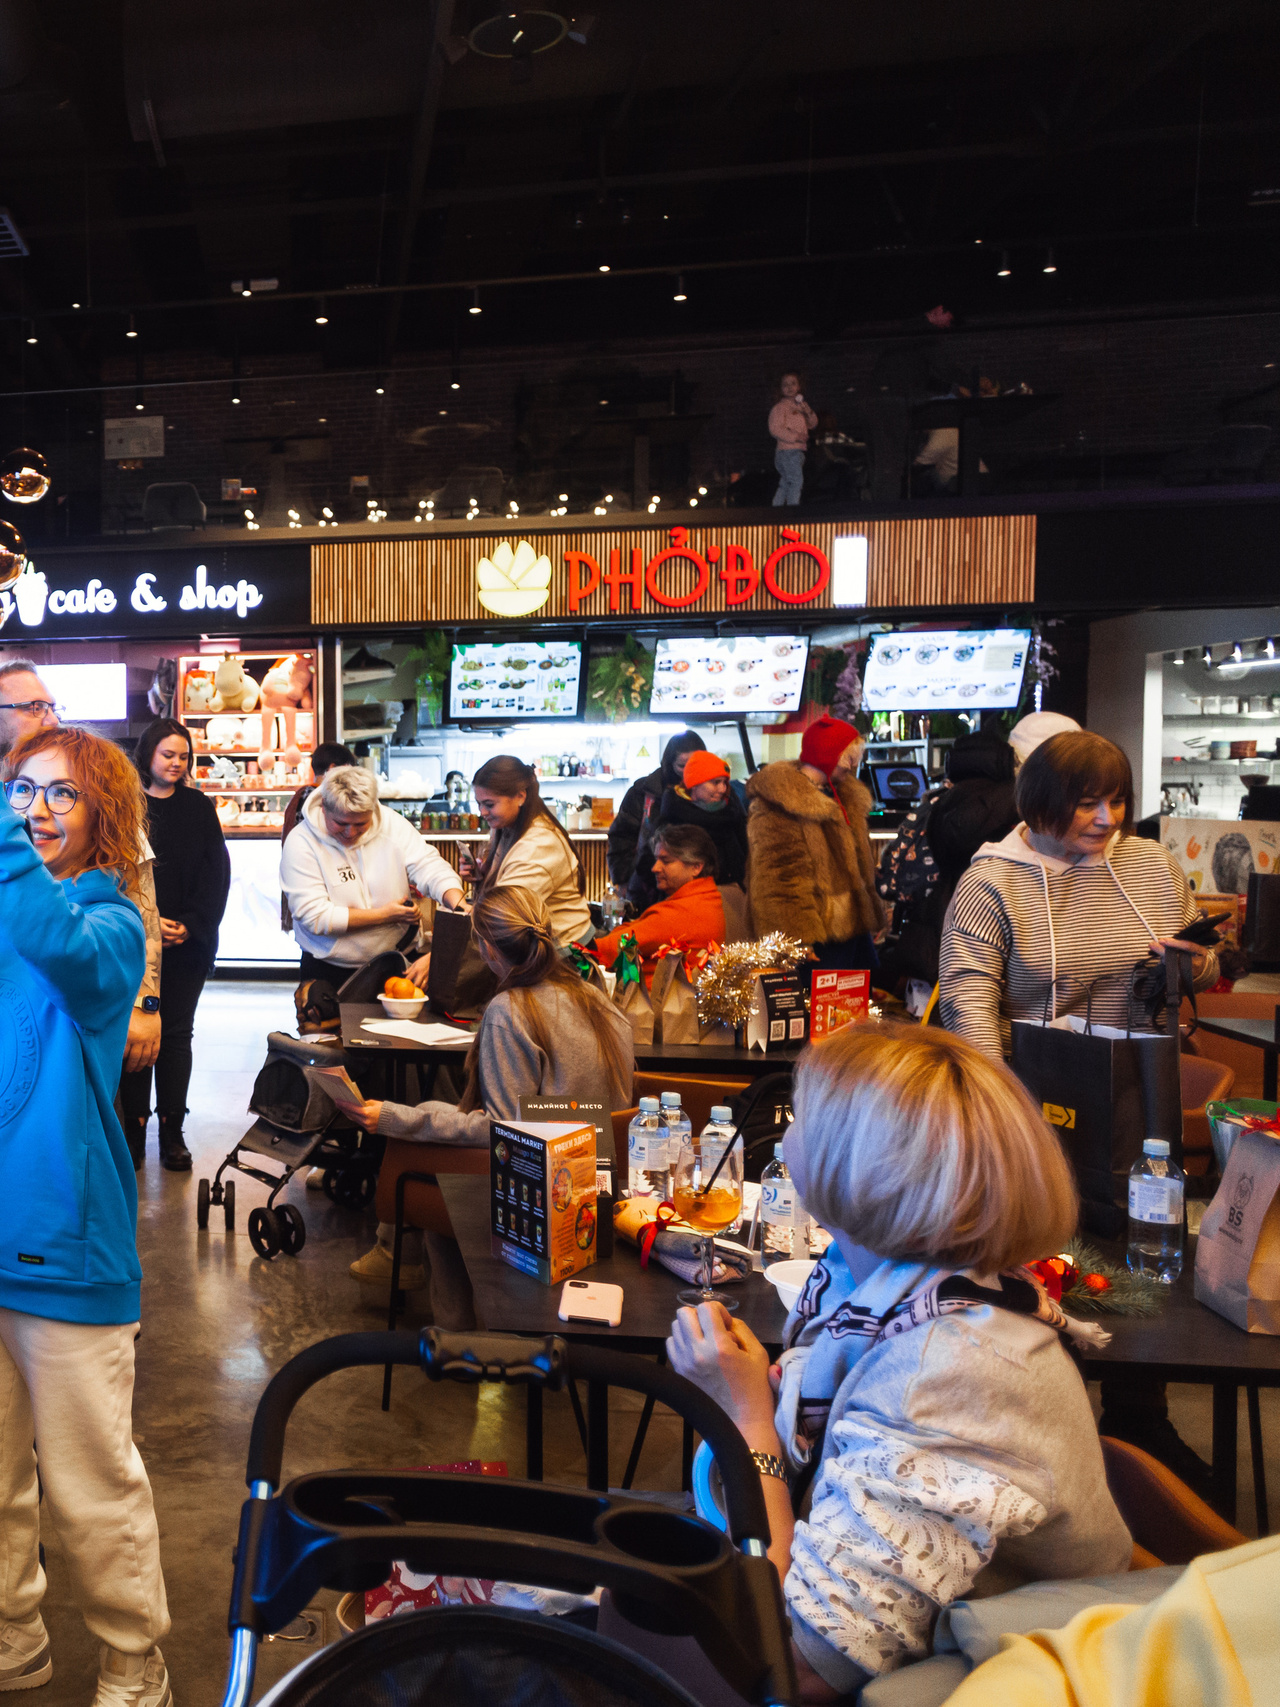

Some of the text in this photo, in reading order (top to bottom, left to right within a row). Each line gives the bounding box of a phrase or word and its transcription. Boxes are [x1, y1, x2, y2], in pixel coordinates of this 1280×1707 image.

[48, 579, 118, 614] cafe
[131, 572, 167, 612] &
[179, 565, 264, 618] shop
[339, 870, 356, 883] 36
[820, 976, 834, 985] 2+1
[494, 1126, 544, 1151] TERMINAL MARKET
[554, 1139, 573, 1154] ГРЕКИ
[573, 1133, 593, 1147] ЗДЕСЬ
[1228, 1206, 1244, 1227] BS
